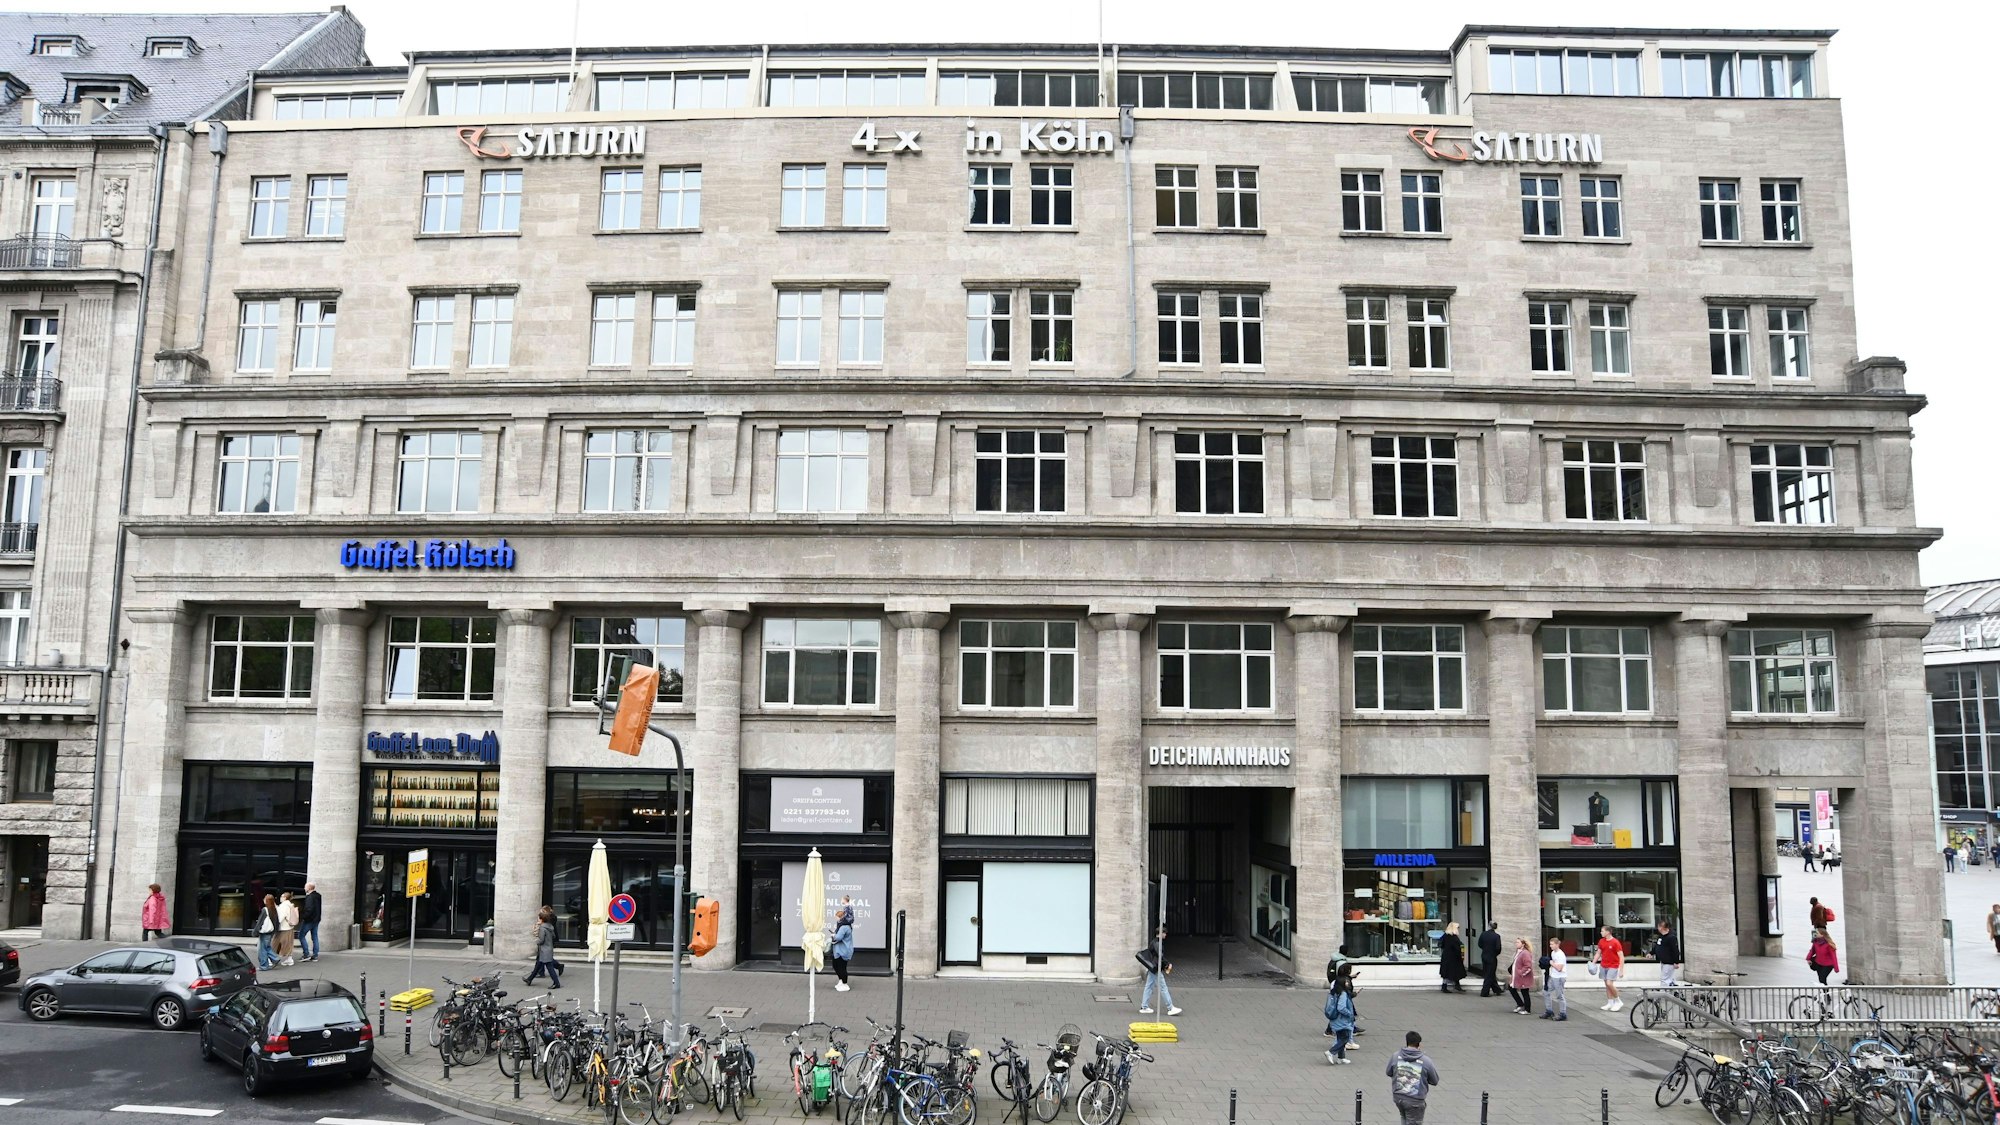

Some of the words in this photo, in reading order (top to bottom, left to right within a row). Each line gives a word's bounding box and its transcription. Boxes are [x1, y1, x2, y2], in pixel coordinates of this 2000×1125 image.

[516, 125, 647, 159] SATURN
[851, 122, 878, 154] 4
[892, 129, 922, 153] x
[966, 120, 1003, 154] in
[1020, 119, 1115, 154] Köln
[1472, 131, 1603, 164] SATURN
[340, 538, 419, 569] Gaffel
[424, 538, 516, 569] Kölsch
[367, 730, 420, 754] Gaffel
[421, 737, 452, 754] am
[1149, 745, 1291, 766] DEICHMANNHAUS
[411, 864, 420, 874] U3
[1374, 853, 1437, 866] MILLENIA
[408, 883, 425, 894] Ende
